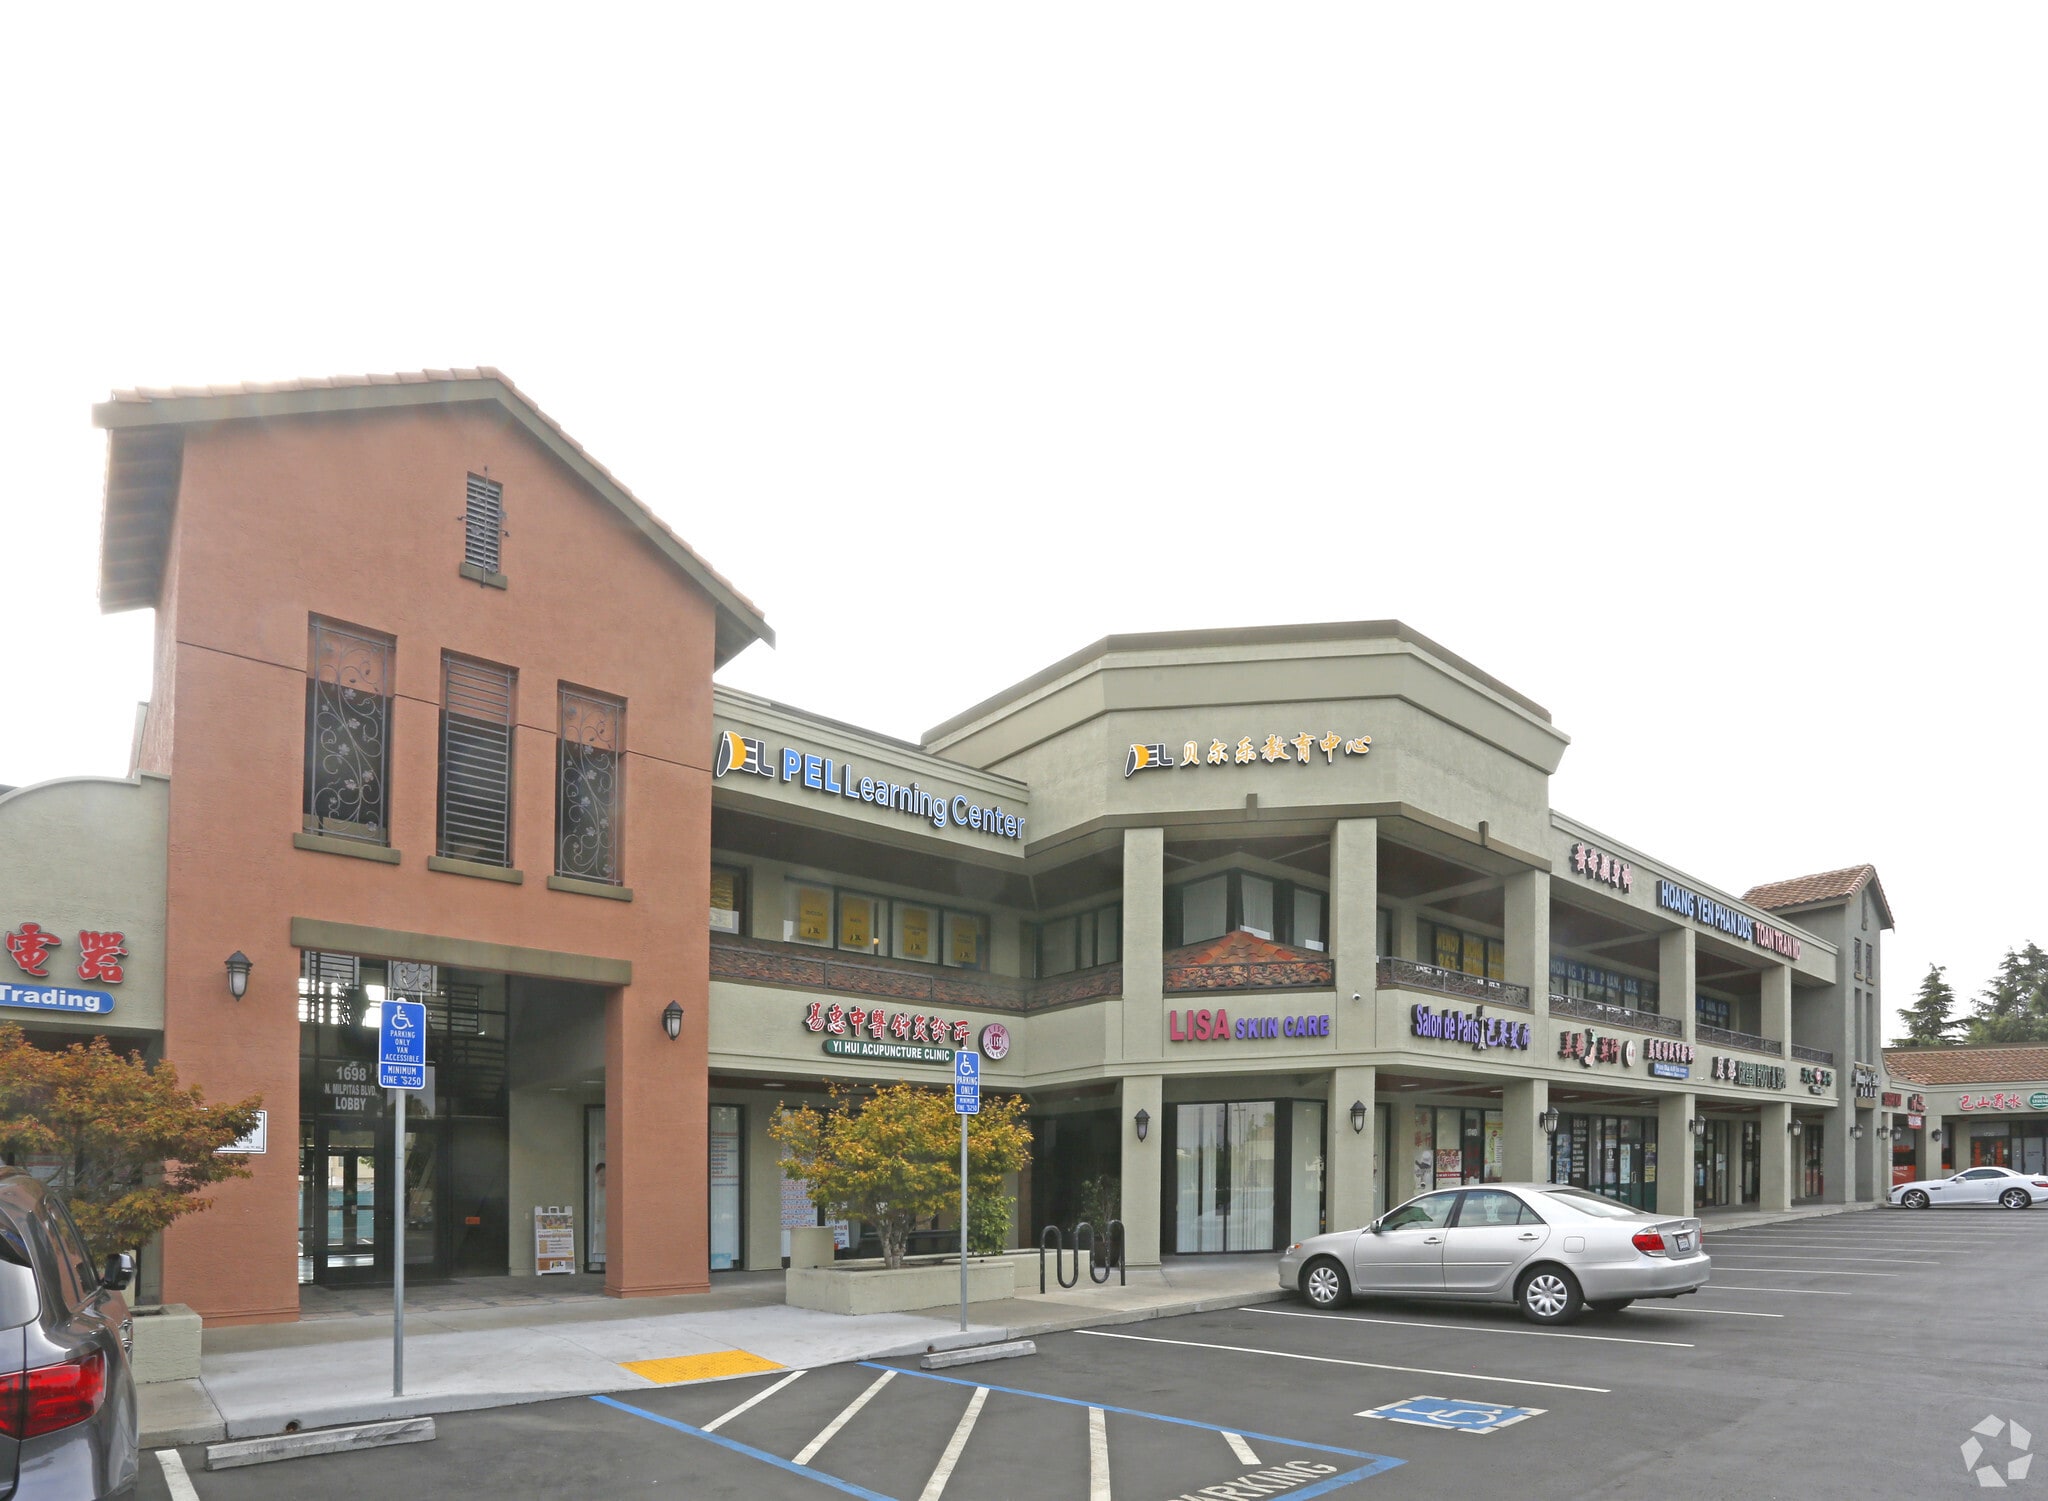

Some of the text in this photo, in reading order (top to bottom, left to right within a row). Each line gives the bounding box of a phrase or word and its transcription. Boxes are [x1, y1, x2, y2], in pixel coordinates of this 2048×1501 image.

[1180, 731, 1372, 769] 贝尔乐教育中心
[782, 747, 1026, 840] PEL Learning Center
[1661, 880, 1753, 941] HOANG YEN PHAN DDS
[1755, 921, 1774, 950] TOAN
[1775, 931, 1792, 957] TRAN
[5, 921, 129, 984] 電器
[0, 984, 101, 1013] Trading
[1169, 1008, 1330, 1041] LISA SKIN CARE
[1415, 1003, 1480, 1043] Salon de Paris
[390, 1029, 415, 1039] PARKING
[394, 1038, 410, 1047] ONLY
[396, 1046, 409, 1054] VAN
[385, 1053, 420, 1063] ACCESSIBLE
[833, 1040, 950, 1062] YI HUI ACUPUNCTURE CLINIC
[336, 1065, 367, 1081] 1698
[388, 1065, 417, 1075] MINIMUM
[383, 1075, 421, 1085] FINE $250
[956, 1075, 978, 1086] PARKING
[324, 1083, 331, 1094] N.
[332, 1083, 360, 1096] MILPITAS
[960, 1085, 974, 1095] ONLY
[335, 1096, 367, 1111] LOBBY
[1168, 1460, 1338, 1501] RKING
